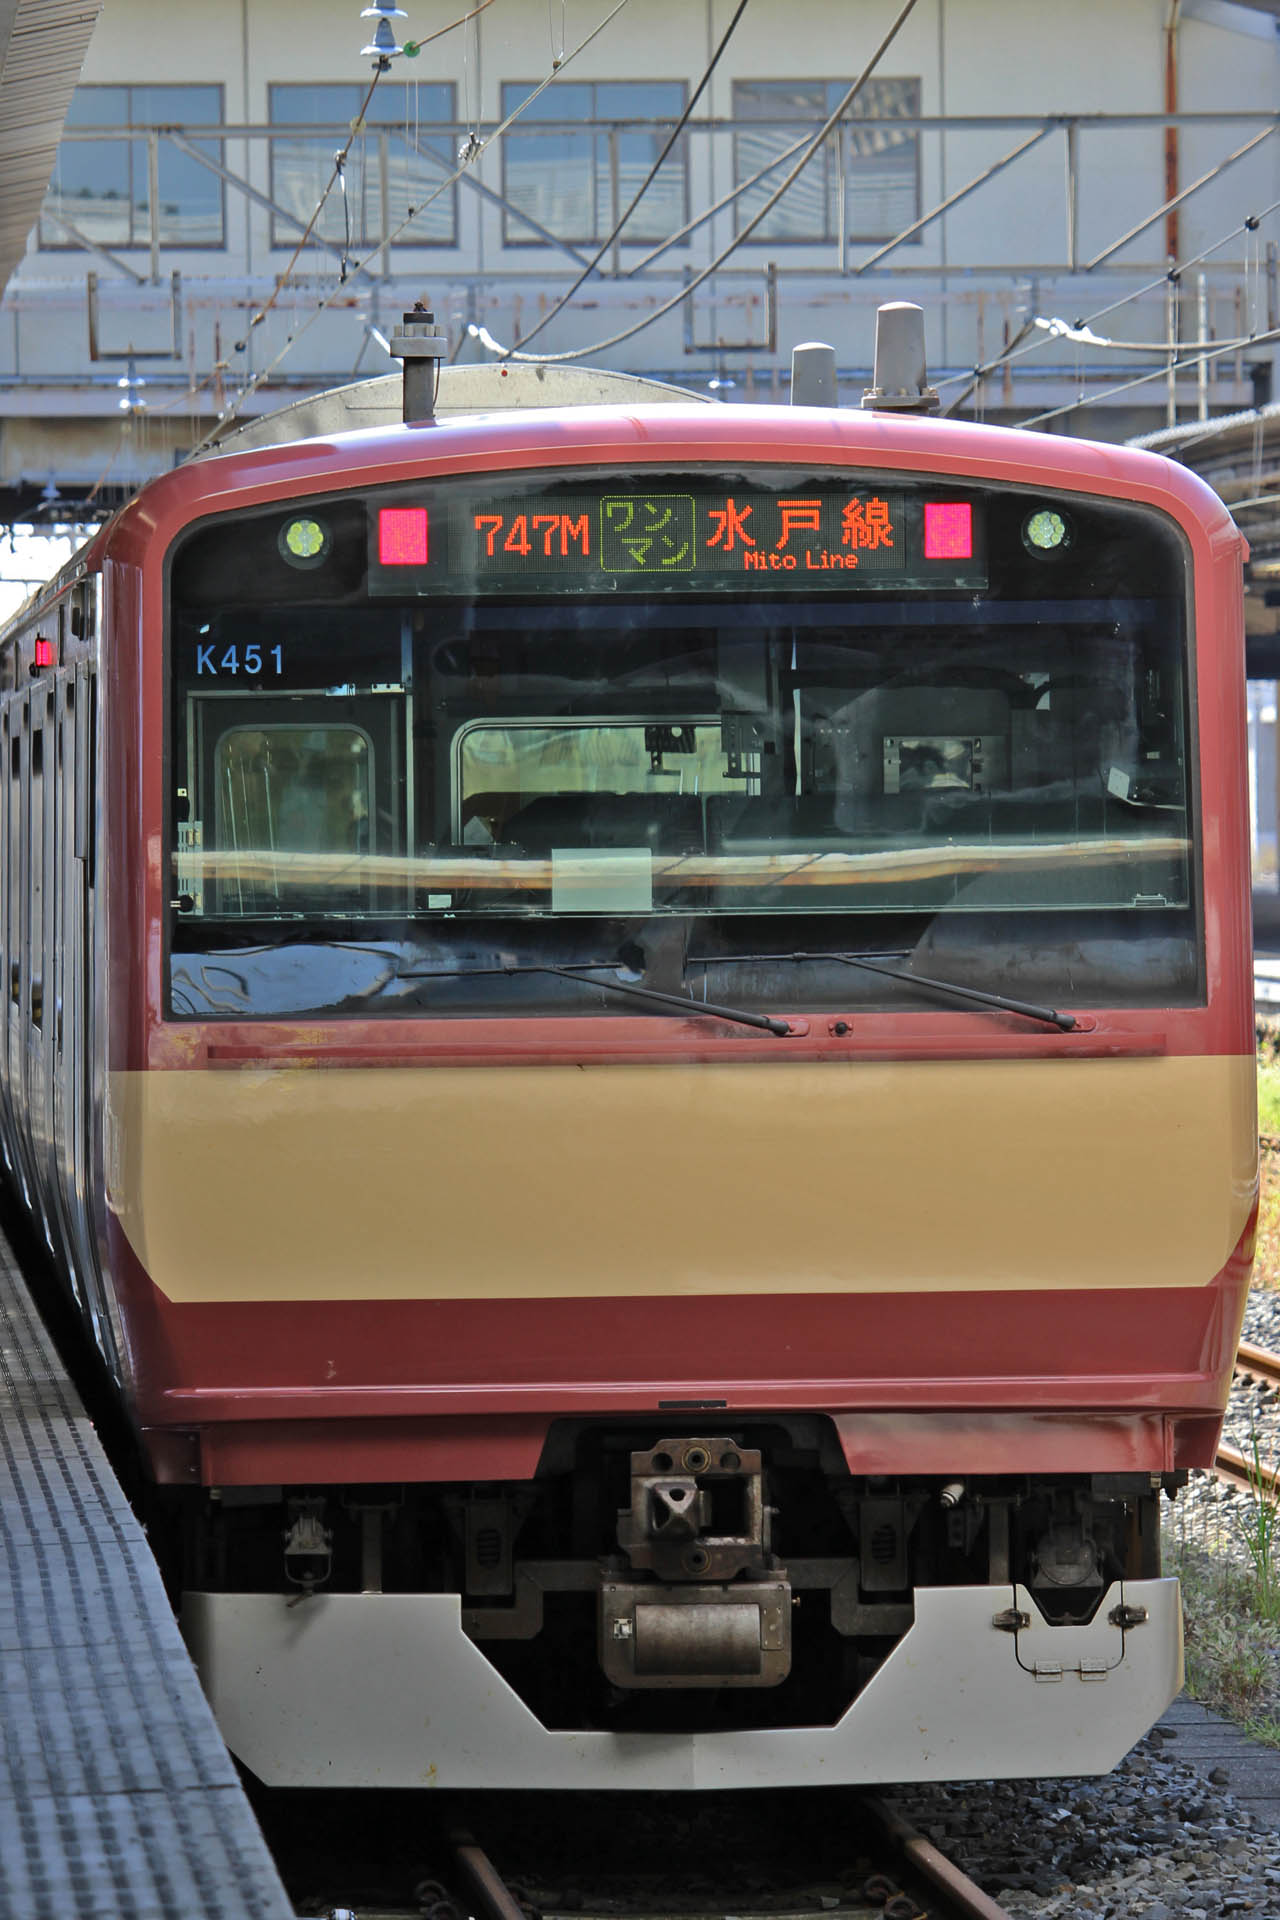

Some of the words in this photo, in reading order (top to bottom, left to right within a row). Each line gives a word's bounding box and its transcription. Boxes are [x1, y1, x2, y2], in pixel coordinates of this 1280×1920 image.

[473, 513, 590, 556] 747M
[706, 497, 893, 551] 水戸線
[744, 551, 797, 571] Mito
[805, 550, 859, 570] Line
[196, 644, 284, 675] K451
